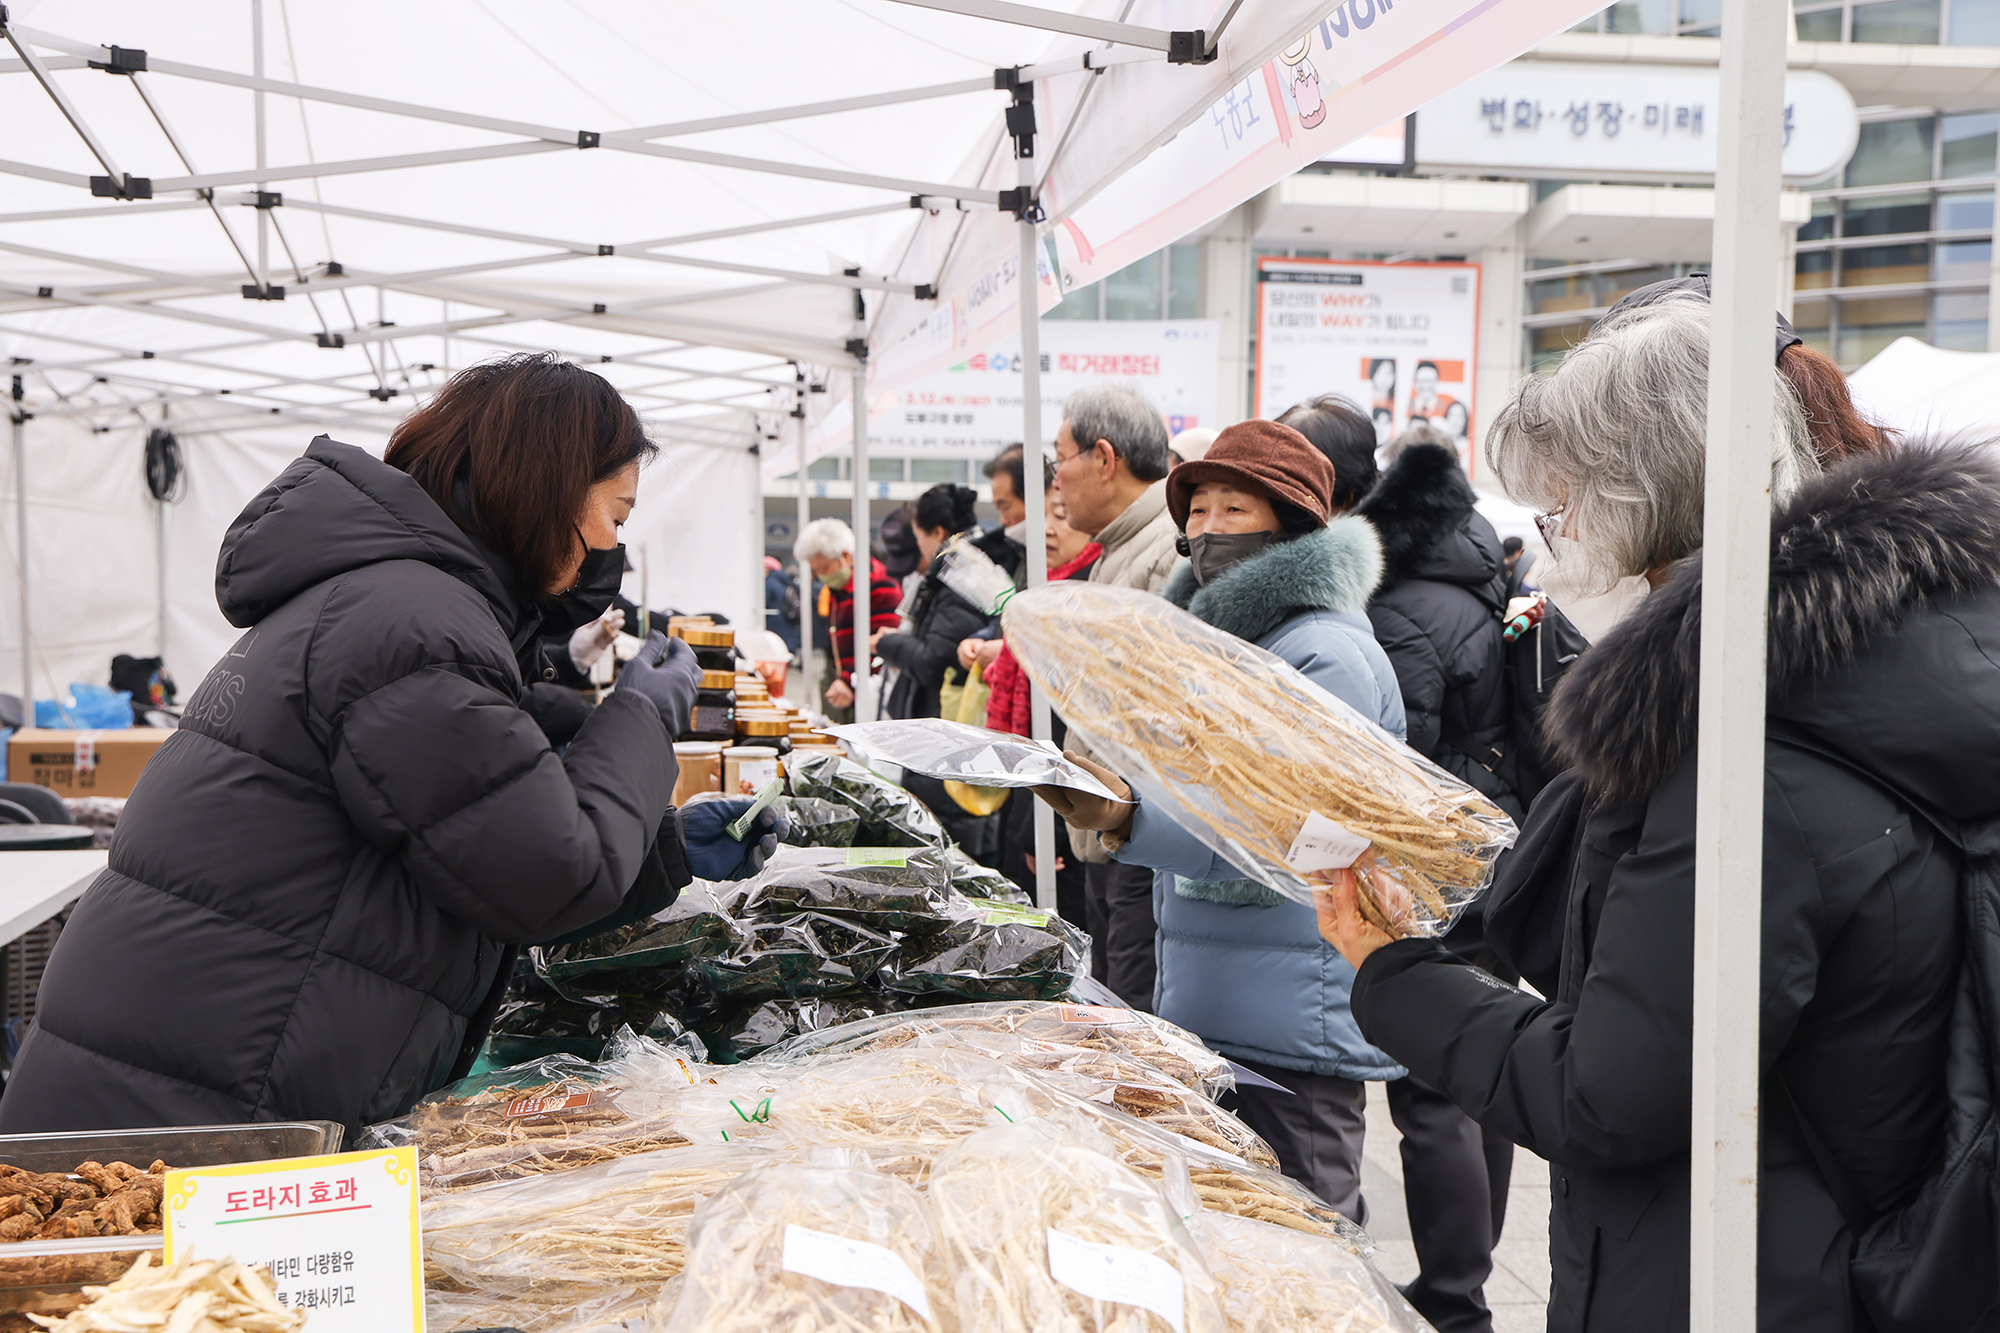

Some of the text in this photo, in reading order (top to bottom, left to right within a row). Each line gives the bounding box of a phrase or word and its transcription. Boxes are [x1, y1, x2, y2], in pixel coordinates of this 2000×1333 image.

[1057, 353, 1160, 375] 직거래장터
[225, 1177, 358, 1212] 도라지 효과
[307, 1250, 355, 1276] 다량함유
[295, 1285, 356, 1310] 강화시키고
